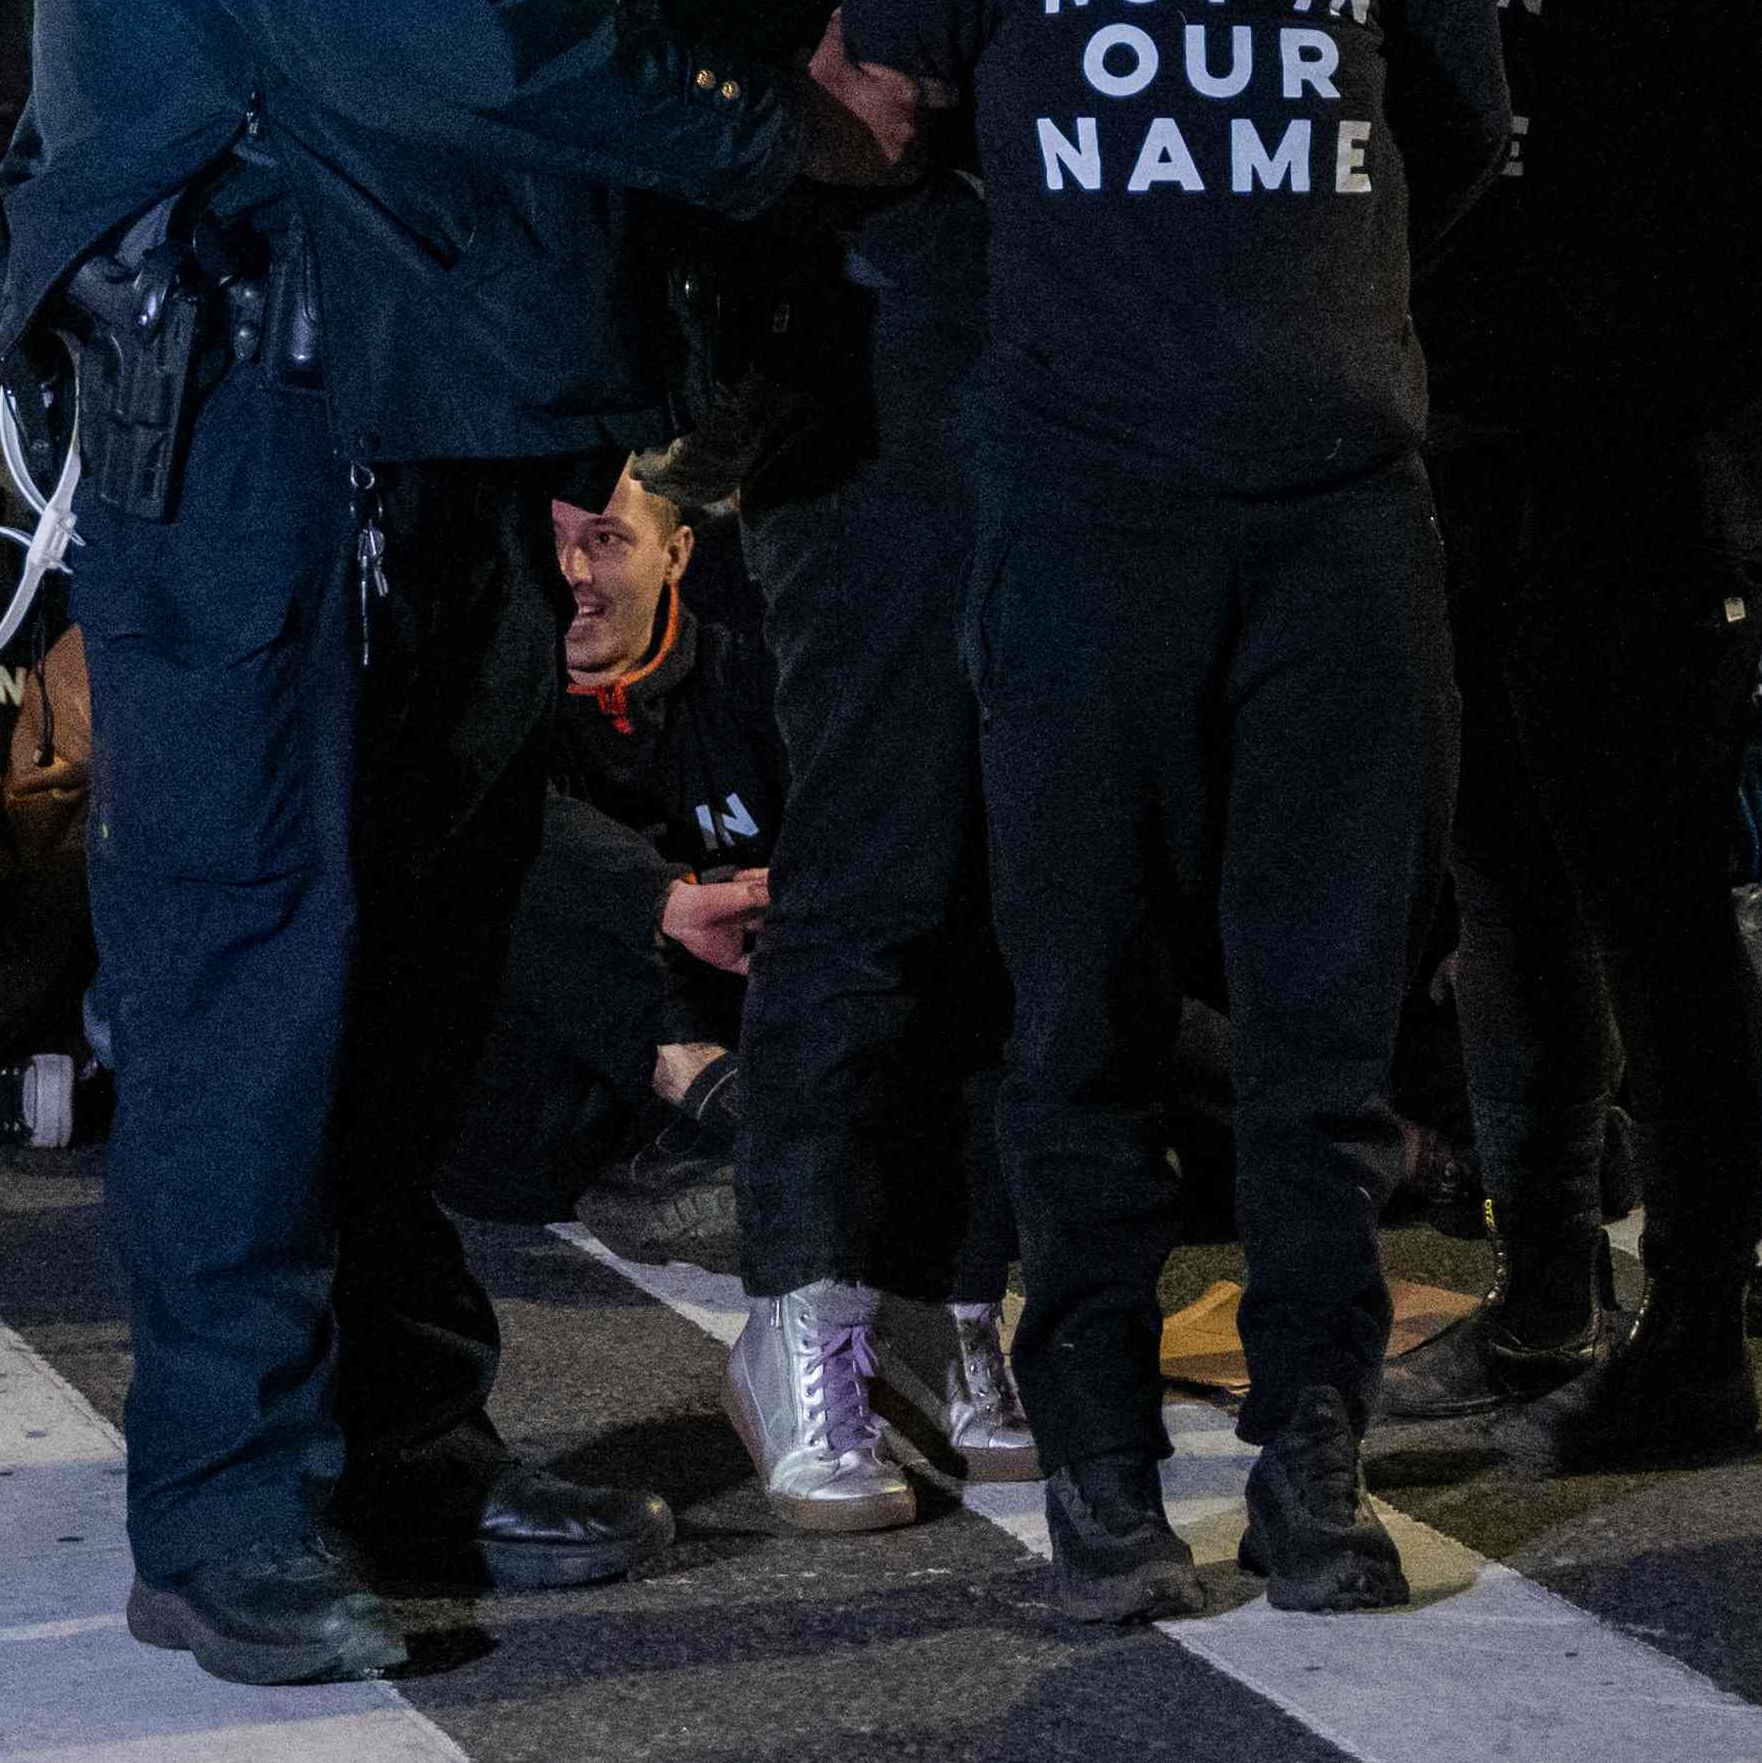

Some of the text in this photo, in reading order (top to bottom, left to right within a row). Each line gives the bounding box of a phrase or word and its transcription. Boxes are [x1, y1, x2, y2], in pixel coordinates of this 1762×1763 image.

[1083, 22, 1341, 99] OUR
[1037, 117, 1373, 194] NAME
[694, 791, 761, 853] IN
